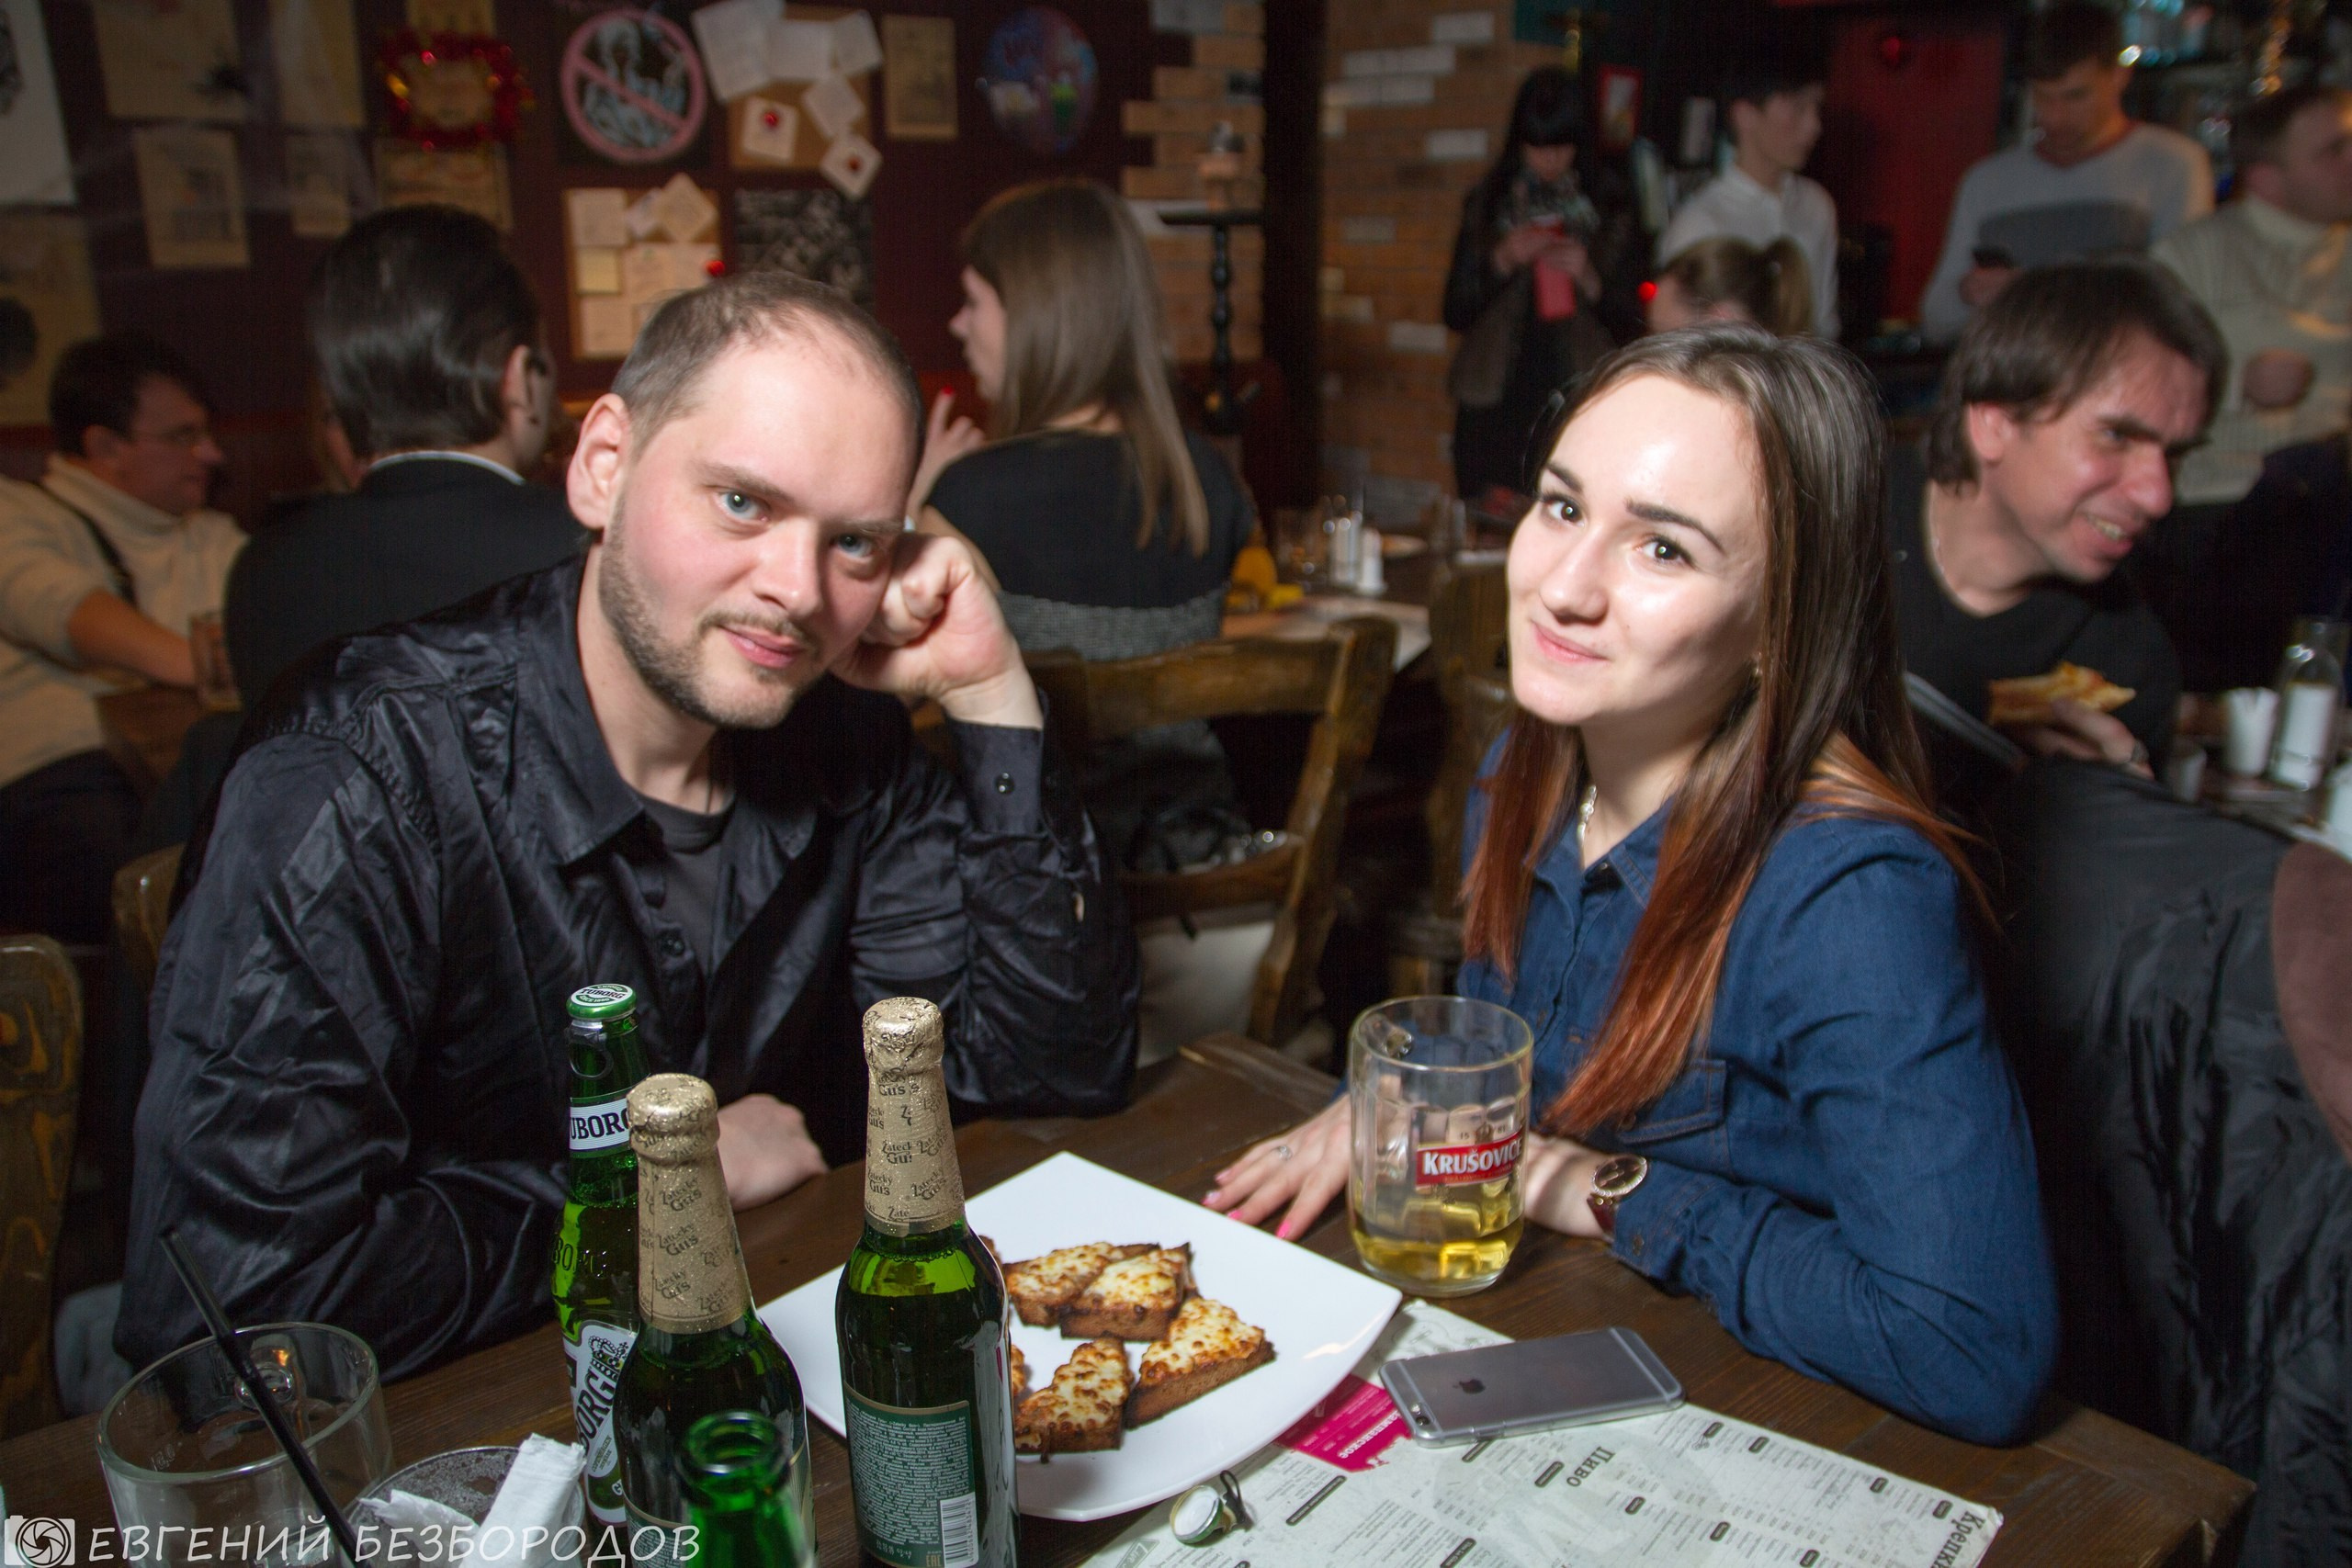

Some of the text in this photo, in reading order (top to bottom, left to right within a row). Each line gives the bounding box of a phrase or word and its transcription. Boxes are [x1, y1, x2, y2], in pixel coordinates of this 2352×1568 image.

[582, 988, 626, 999] TUBORG
[1423, 1137, 1523, 1176] KRUŠOVICE
[1337, 1409, 1402, 1460] ампанское
[1566, 1445, 1617, 1488] Пиво
